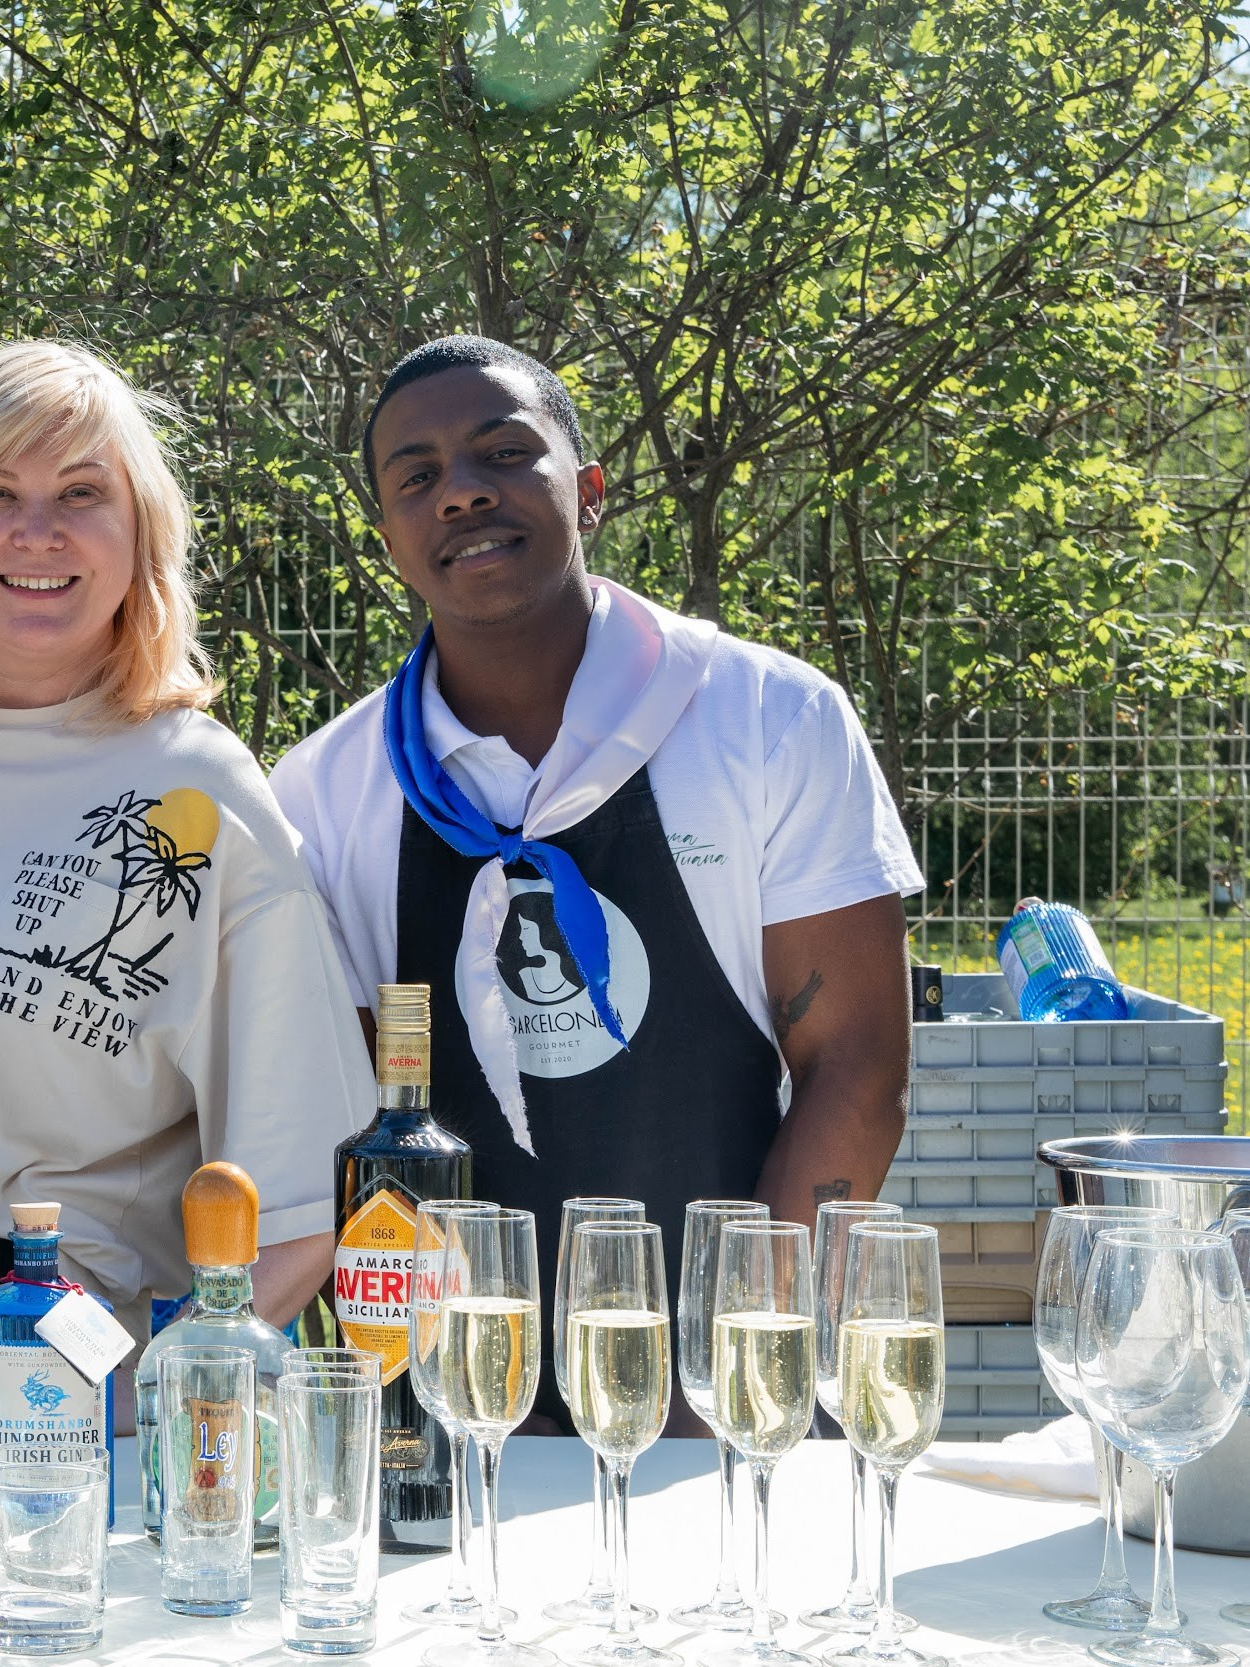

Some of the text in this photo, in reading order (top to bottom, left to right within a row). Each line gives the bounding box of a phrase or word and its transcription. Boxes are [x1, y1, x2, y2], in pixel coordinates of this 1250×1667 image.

[22, 851, 102, 878] CAN YOU
[14, 870, 85, 900] PLEASE
[11, 890, 65, 918] SHUT
[15, 913, 42, 935] UP
[58, 990, 138, 1039] ENJOY
[52, 1015, 128, 1058] VIEW
[529, 1040, 581, 1051] GOURMET
[387, 1058, 422, 1067] AVERNA
[370, 1227, 395, 1240] 1868
[200, 1277, 243, 1288] ENVASADO
[205, 1293, 239, 1309] ORIGEN
[216, 1289, 228, 1298] DE
[6, 1448, 83, 1464] IRISH GIN
[196, 1421, 239, 1472] Ley
